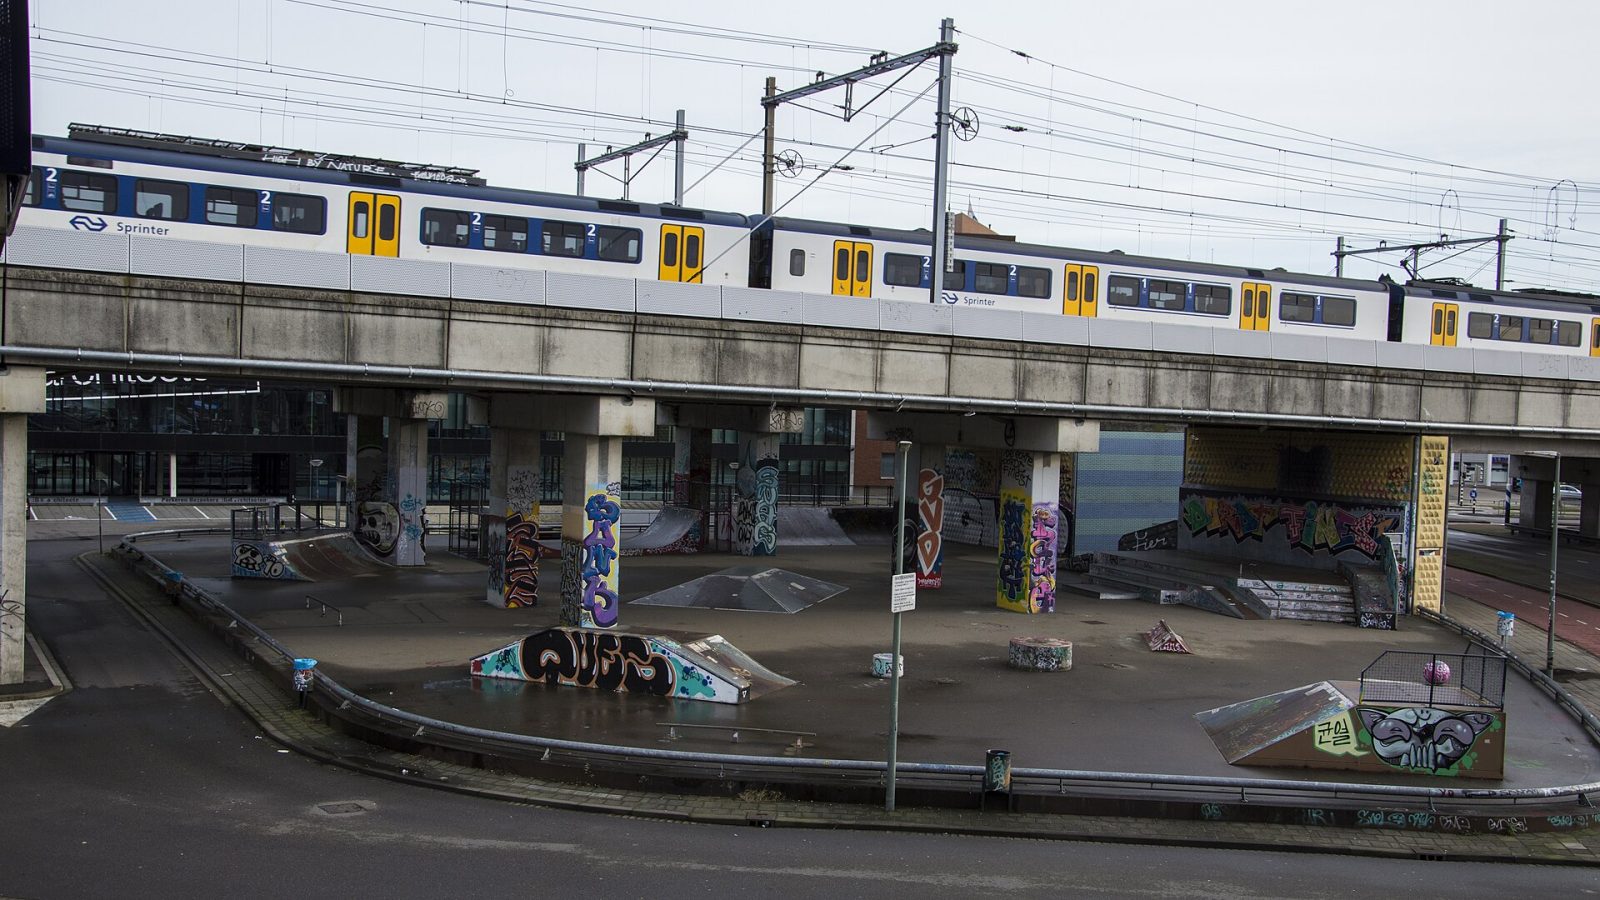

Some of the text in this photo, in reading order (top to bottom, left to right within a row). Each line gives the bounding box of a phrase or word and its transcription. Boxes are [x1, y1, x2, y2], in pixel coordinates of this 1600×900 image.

[46, 168, 57, 181] 2
[261, 191, 271, 204] 2
[472, 213, 481, 225] 2
[117, 222, 169, 235] Sprinter
[587, 224, 596, 236] 2
[923, 256, 931, 268] 2
[1009, 265, 1017, 276] 2
[1142, 278, 1147, 289] 1
[1187, 283, 1192, 294] 1
[964, 296, 995, 306] Sprinter
[1316, 295, 1320, 305] 1
[1494, 314, 1499, 323] 2
[1553, 320, 1558, 328] 2
[918, 468, 944, 577] GVD
[1318, 718, 1350, 746] 균열
